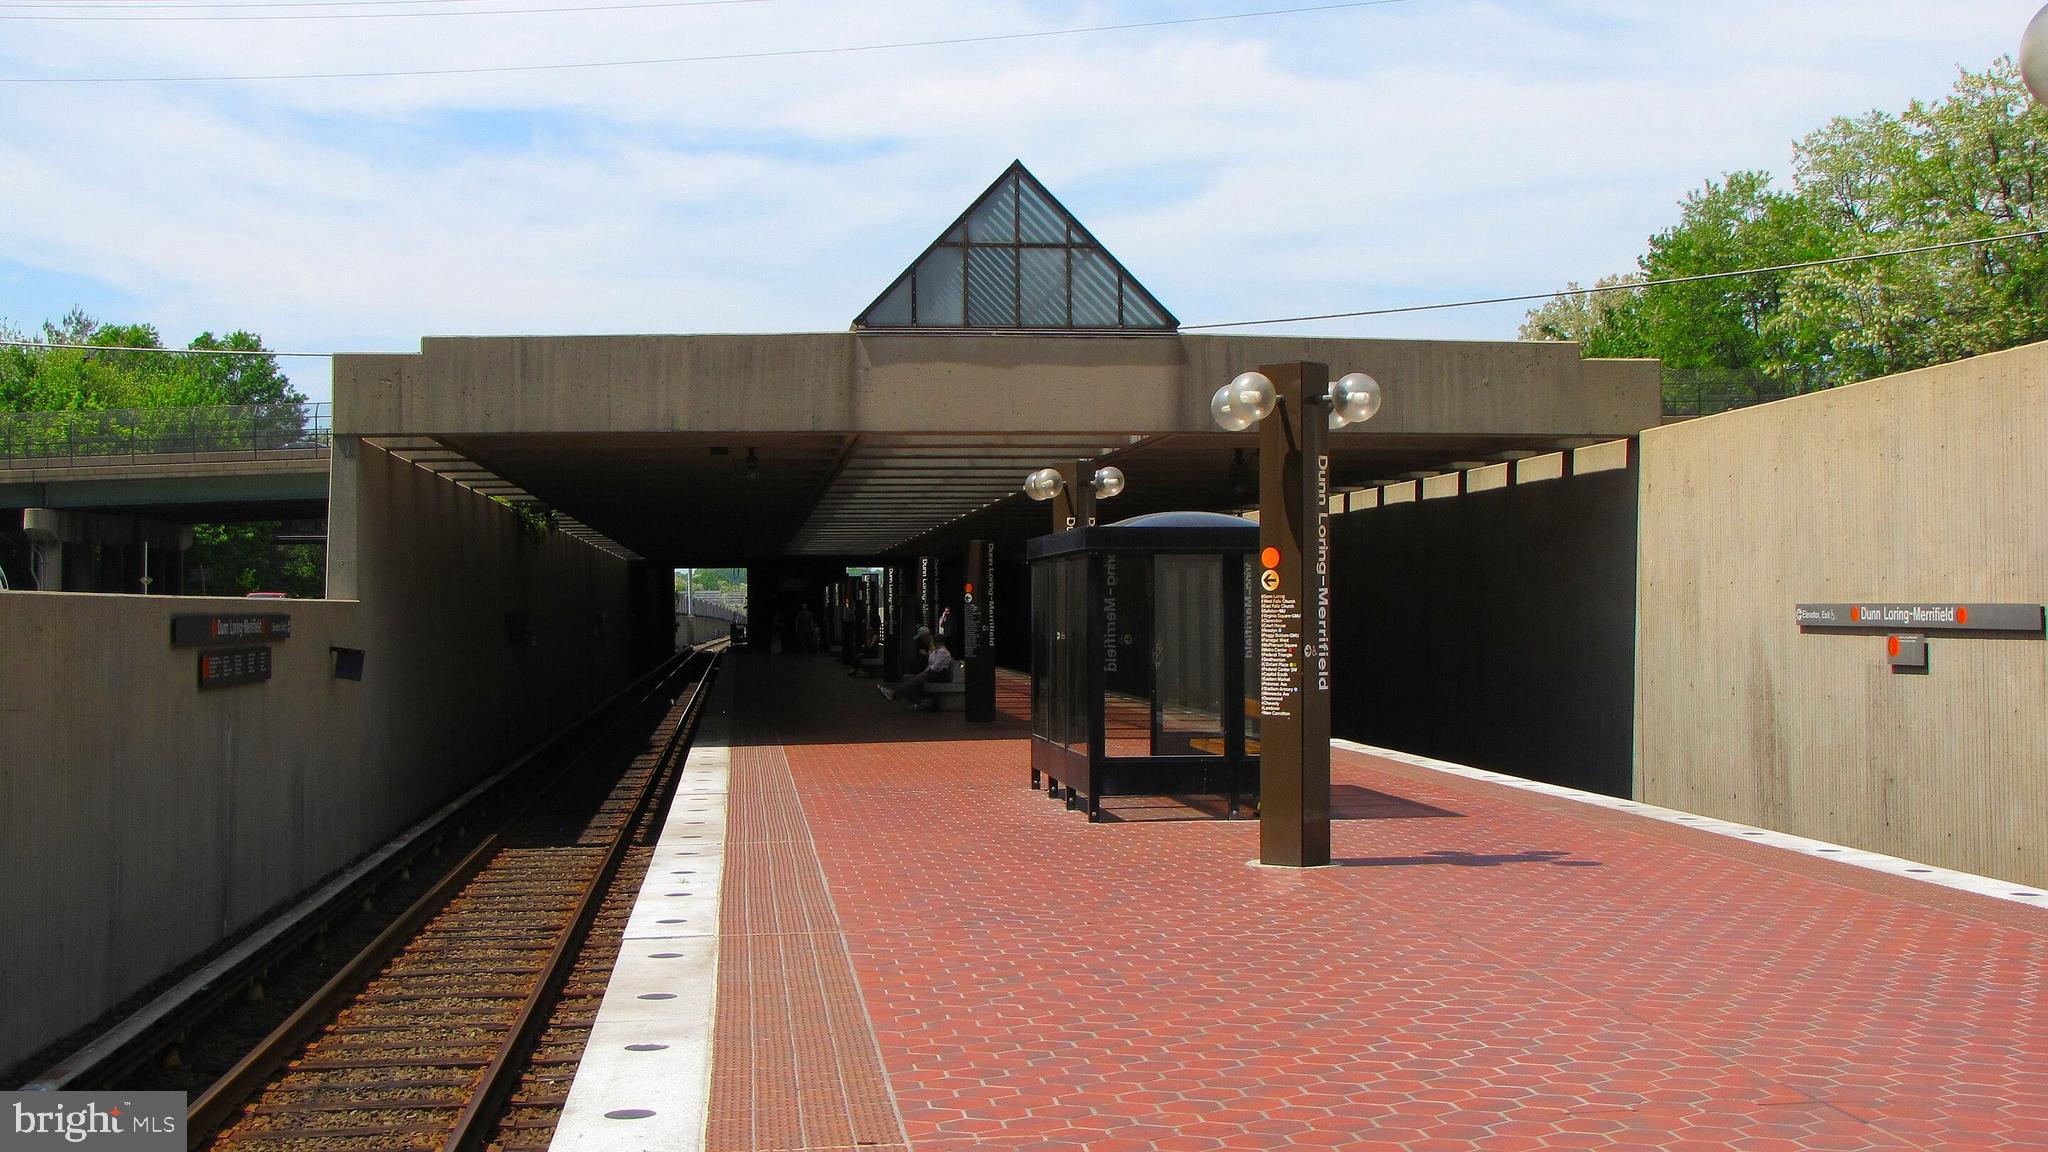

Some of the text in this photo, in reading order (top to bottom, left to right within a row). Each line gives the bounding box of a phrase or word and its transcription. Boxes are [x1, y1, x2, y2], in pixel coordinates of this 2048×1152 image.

[1316, 455, 1329, 691] Dunn Loring-Merrifield
[1860, 606, 1954, 624] Dunn Loring-Merrifield
